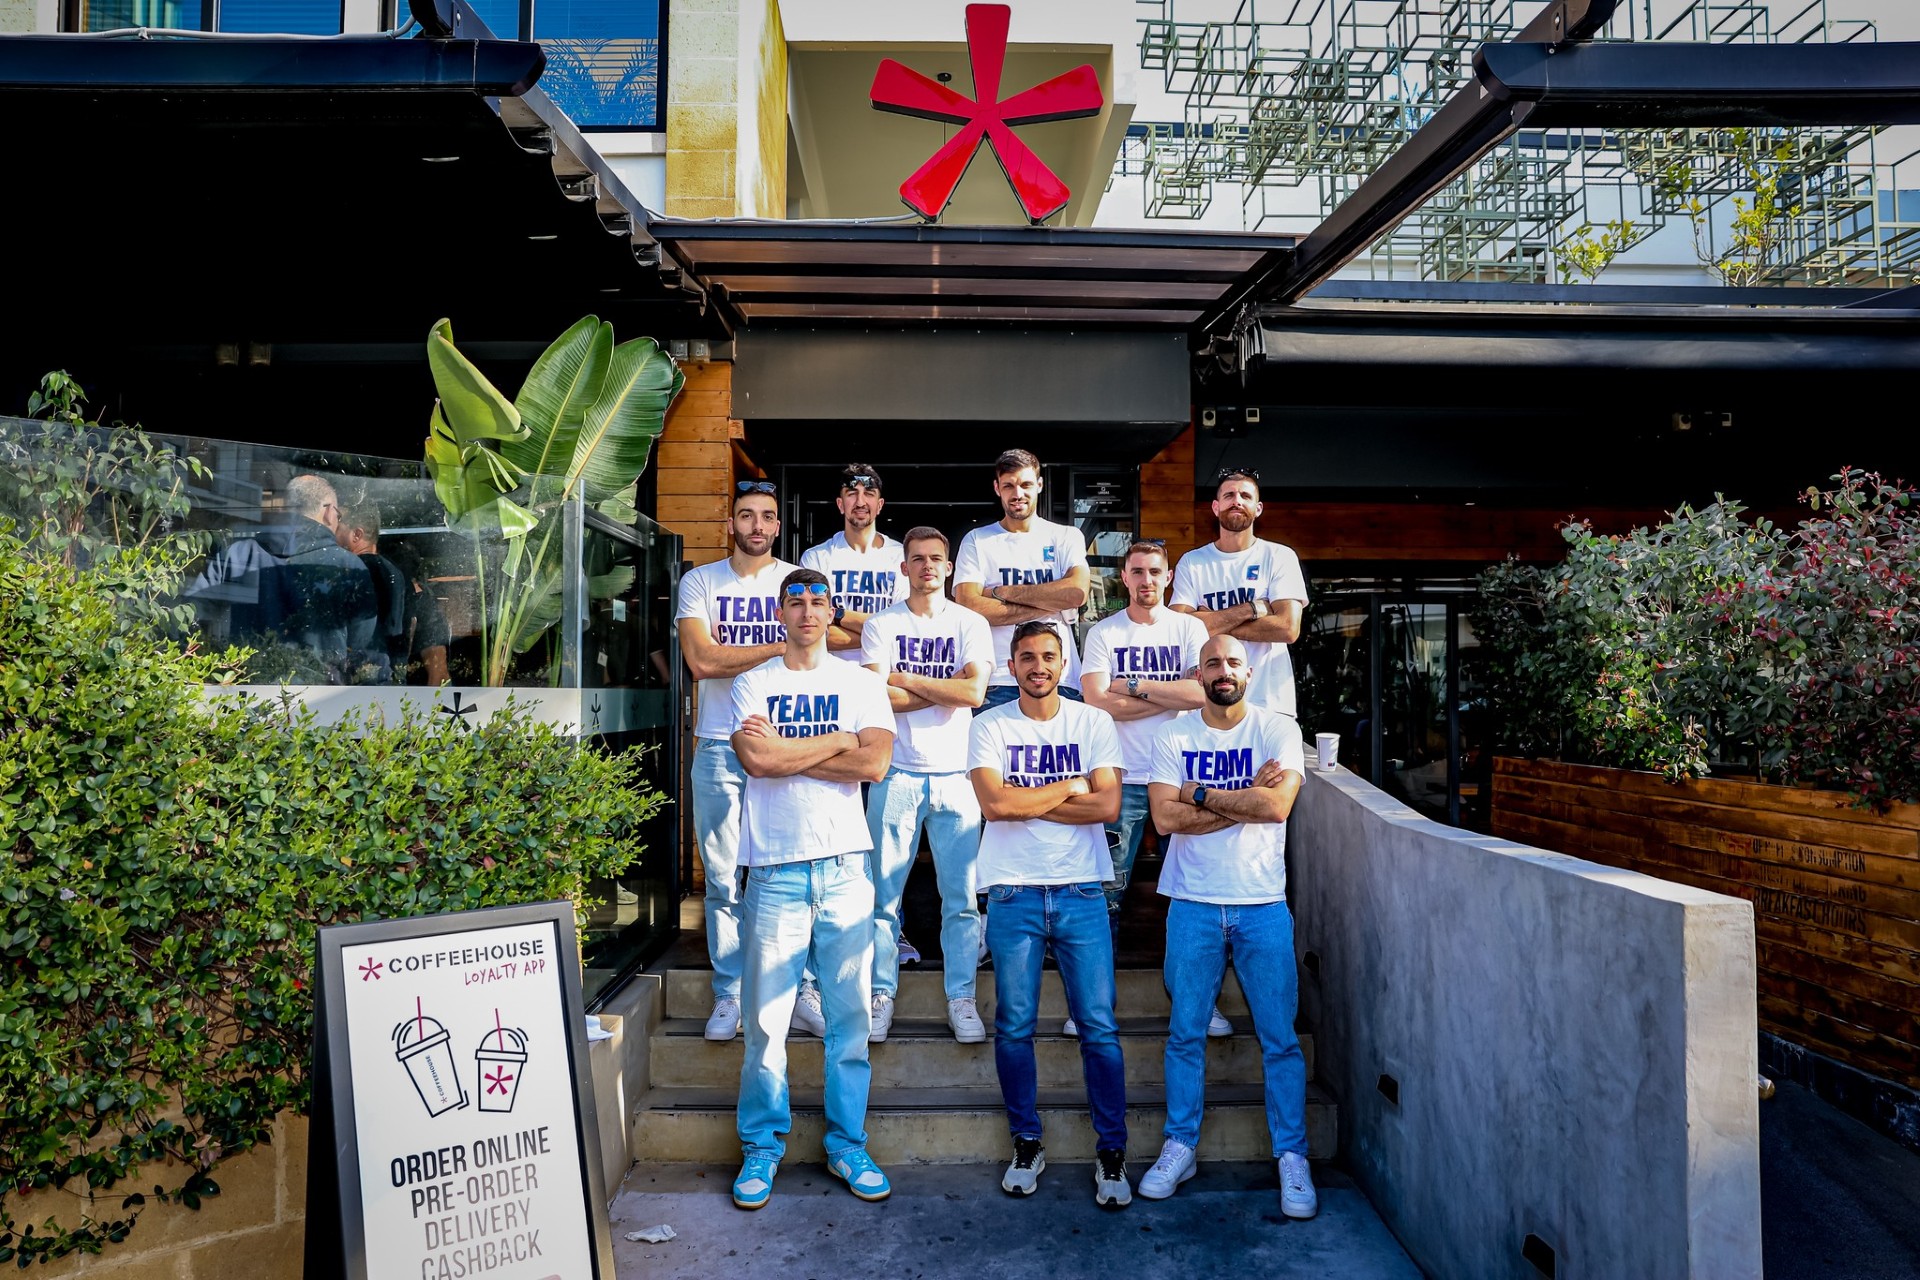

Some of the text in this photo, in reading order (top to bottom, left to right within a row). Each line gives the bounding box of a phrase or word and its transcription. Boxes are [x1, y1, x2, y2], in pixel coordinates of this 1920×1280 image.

[832, 570, 896, 597] TEAM
[896, 635, 955, 663] TEAM
[1114, 645, 1181, 672] TEAM
[766, 694, 839, 723] TEAM
[1007, 744, 1082, 774] TEAM
[1182, 748, 1253, 781] TEAM
[389, 939, 544, 973] COFFEEHOUSE
[464, 958, 546, 986] LOYALTY APP
[390, 1126, 551, 1188] ORDER ONLINE
[411, 1163, 539, 1219] PRE-ORDER
[424, 1197, 531, 1251] DELIVERY
[421, 1229, 543, 1280] CASHBACK
